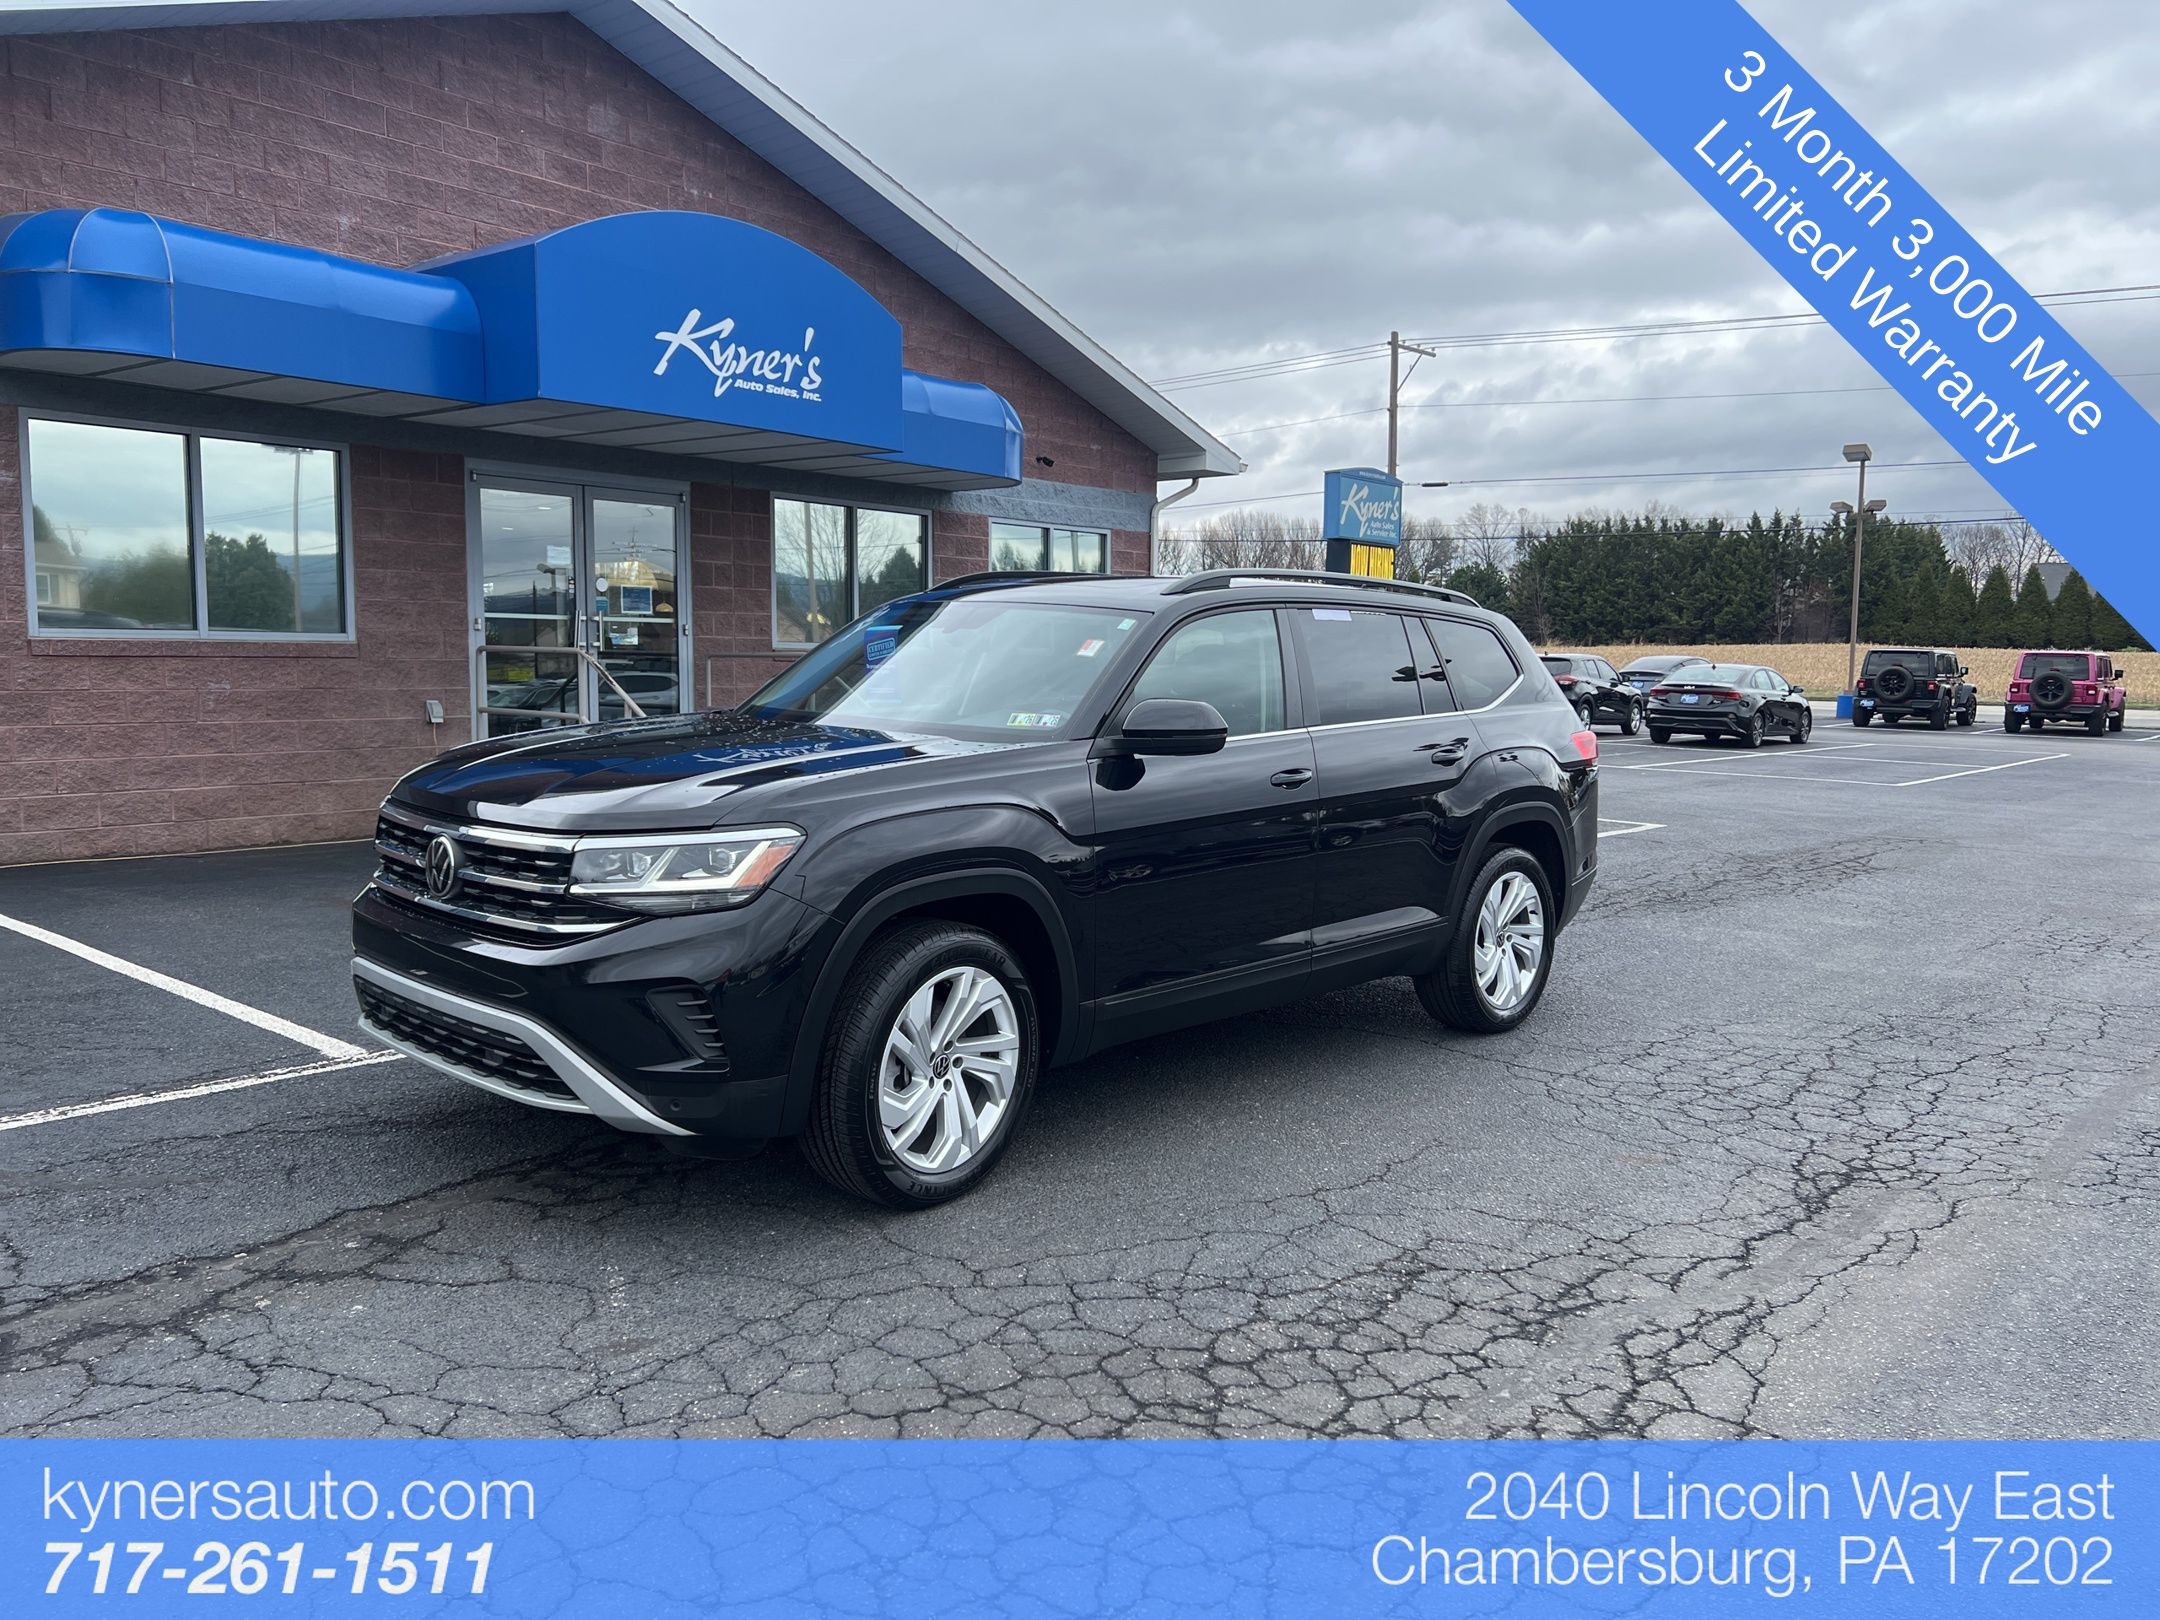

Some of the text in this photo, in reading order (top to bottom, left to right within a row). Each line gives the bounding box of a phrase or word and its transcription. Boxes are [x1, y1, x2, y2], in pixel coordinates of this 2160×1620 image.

[653, 308, 822, 398] Kyner's
[734, 379, 822, 402] Auto Sales, Inc.
[1341, 483, 1399, 538] Kyner's
